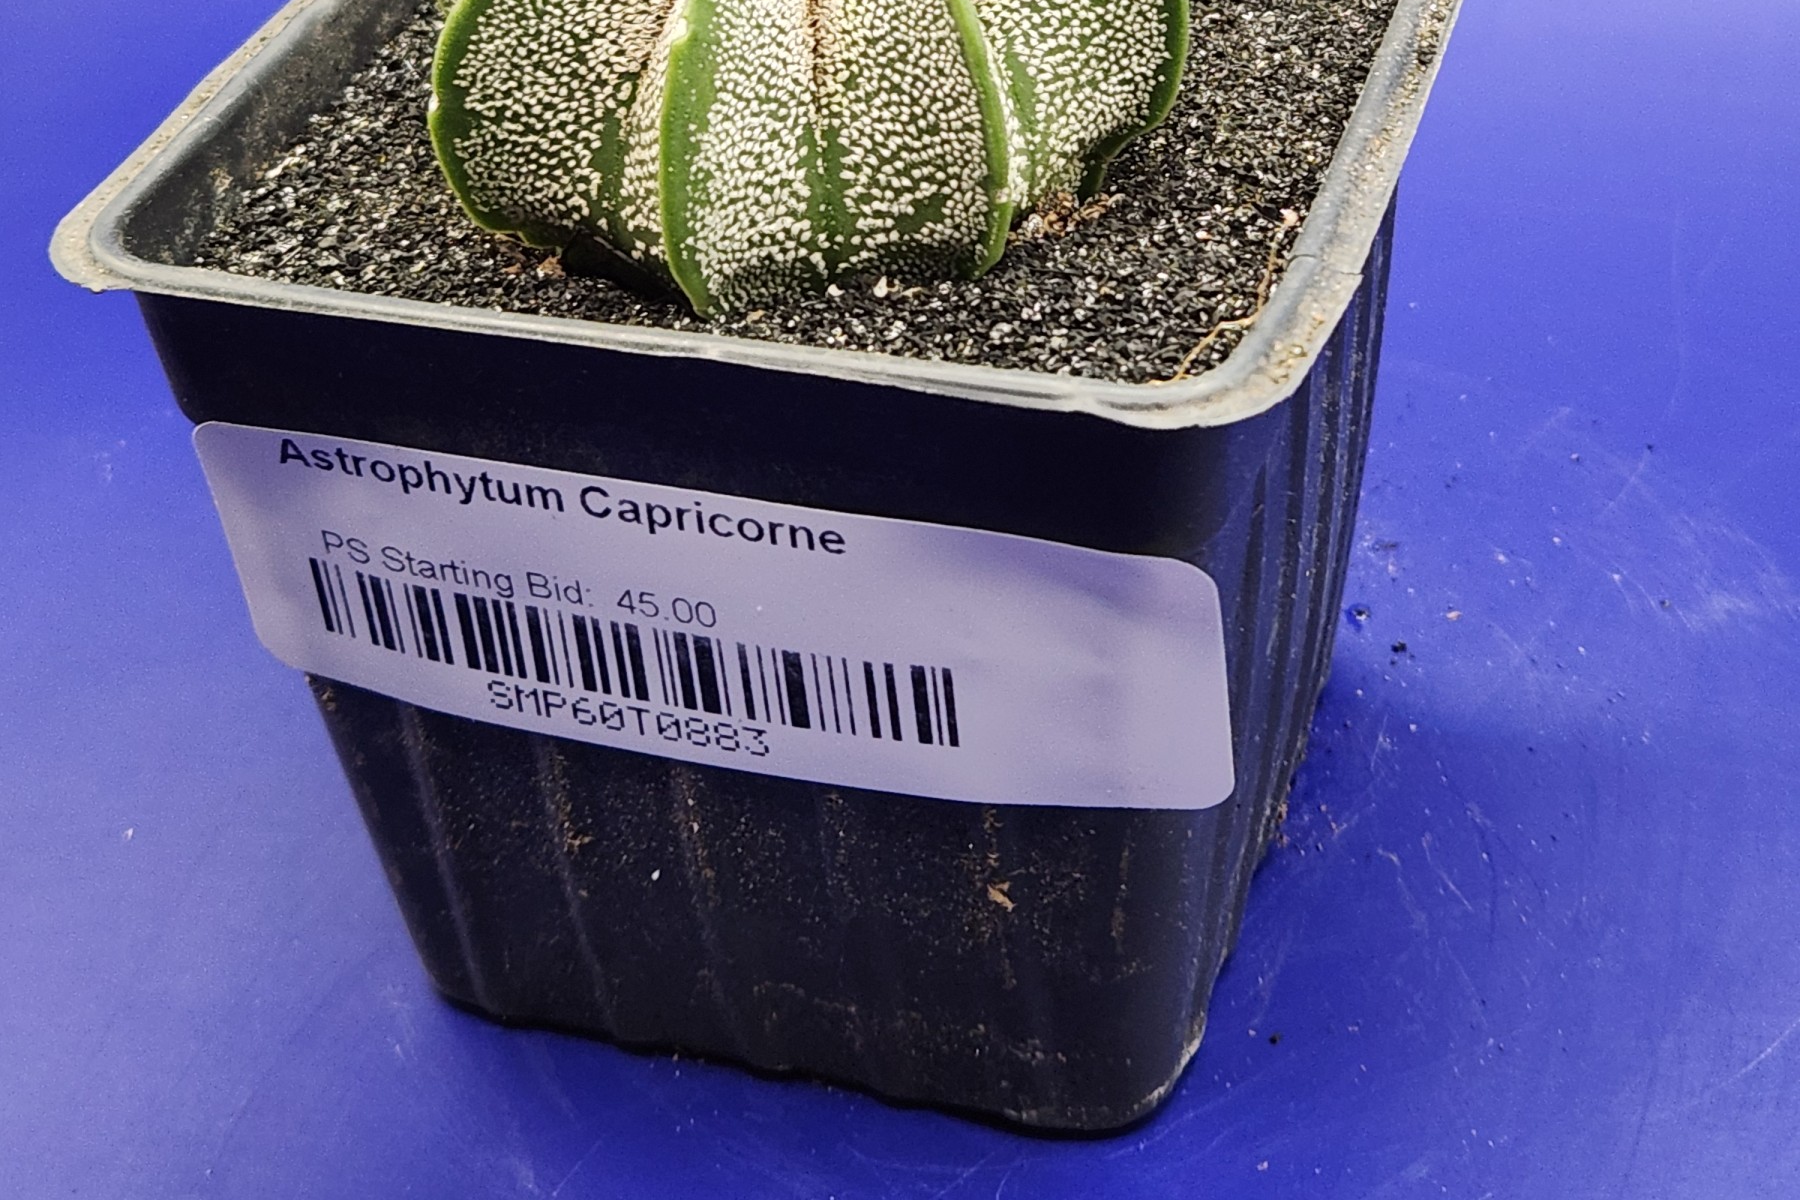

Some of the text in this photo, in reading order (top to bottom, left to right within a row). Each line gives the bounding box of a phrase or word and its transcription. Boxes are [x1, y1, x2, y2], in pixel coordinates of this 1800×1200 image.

[279, 437, 847, 555] Astrophytum Capricorne
[320, 529, 718, 629] PS Starting Bid: 45.00
[487, 679, 771, 757] SMP60T0883
